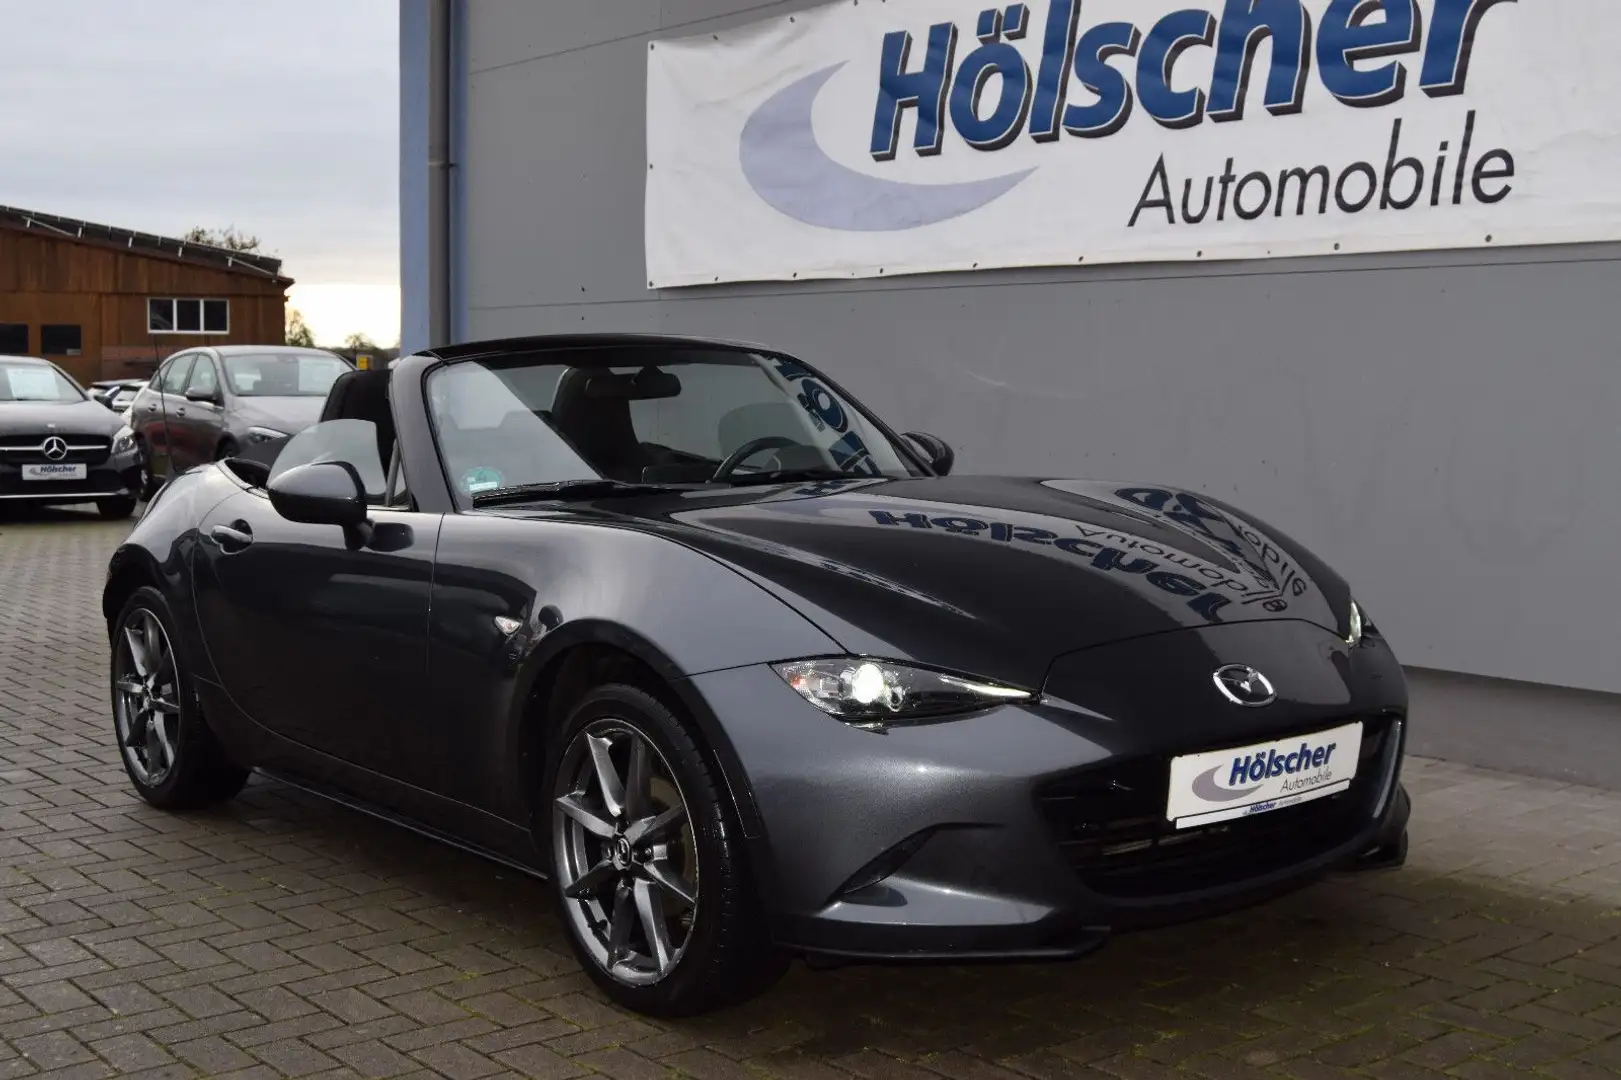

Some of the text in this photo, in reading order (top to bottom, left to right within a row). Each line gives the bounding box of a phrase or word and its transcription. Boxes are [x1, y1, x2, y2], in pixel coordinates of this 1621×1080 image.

[870, 0, 1519, 162] Hölscher
[1127, 110, 1514, 227] Automobile
[1229, 743, 1336, 786] Hölscher
[1280, 766, 1332, 792] Automobile
